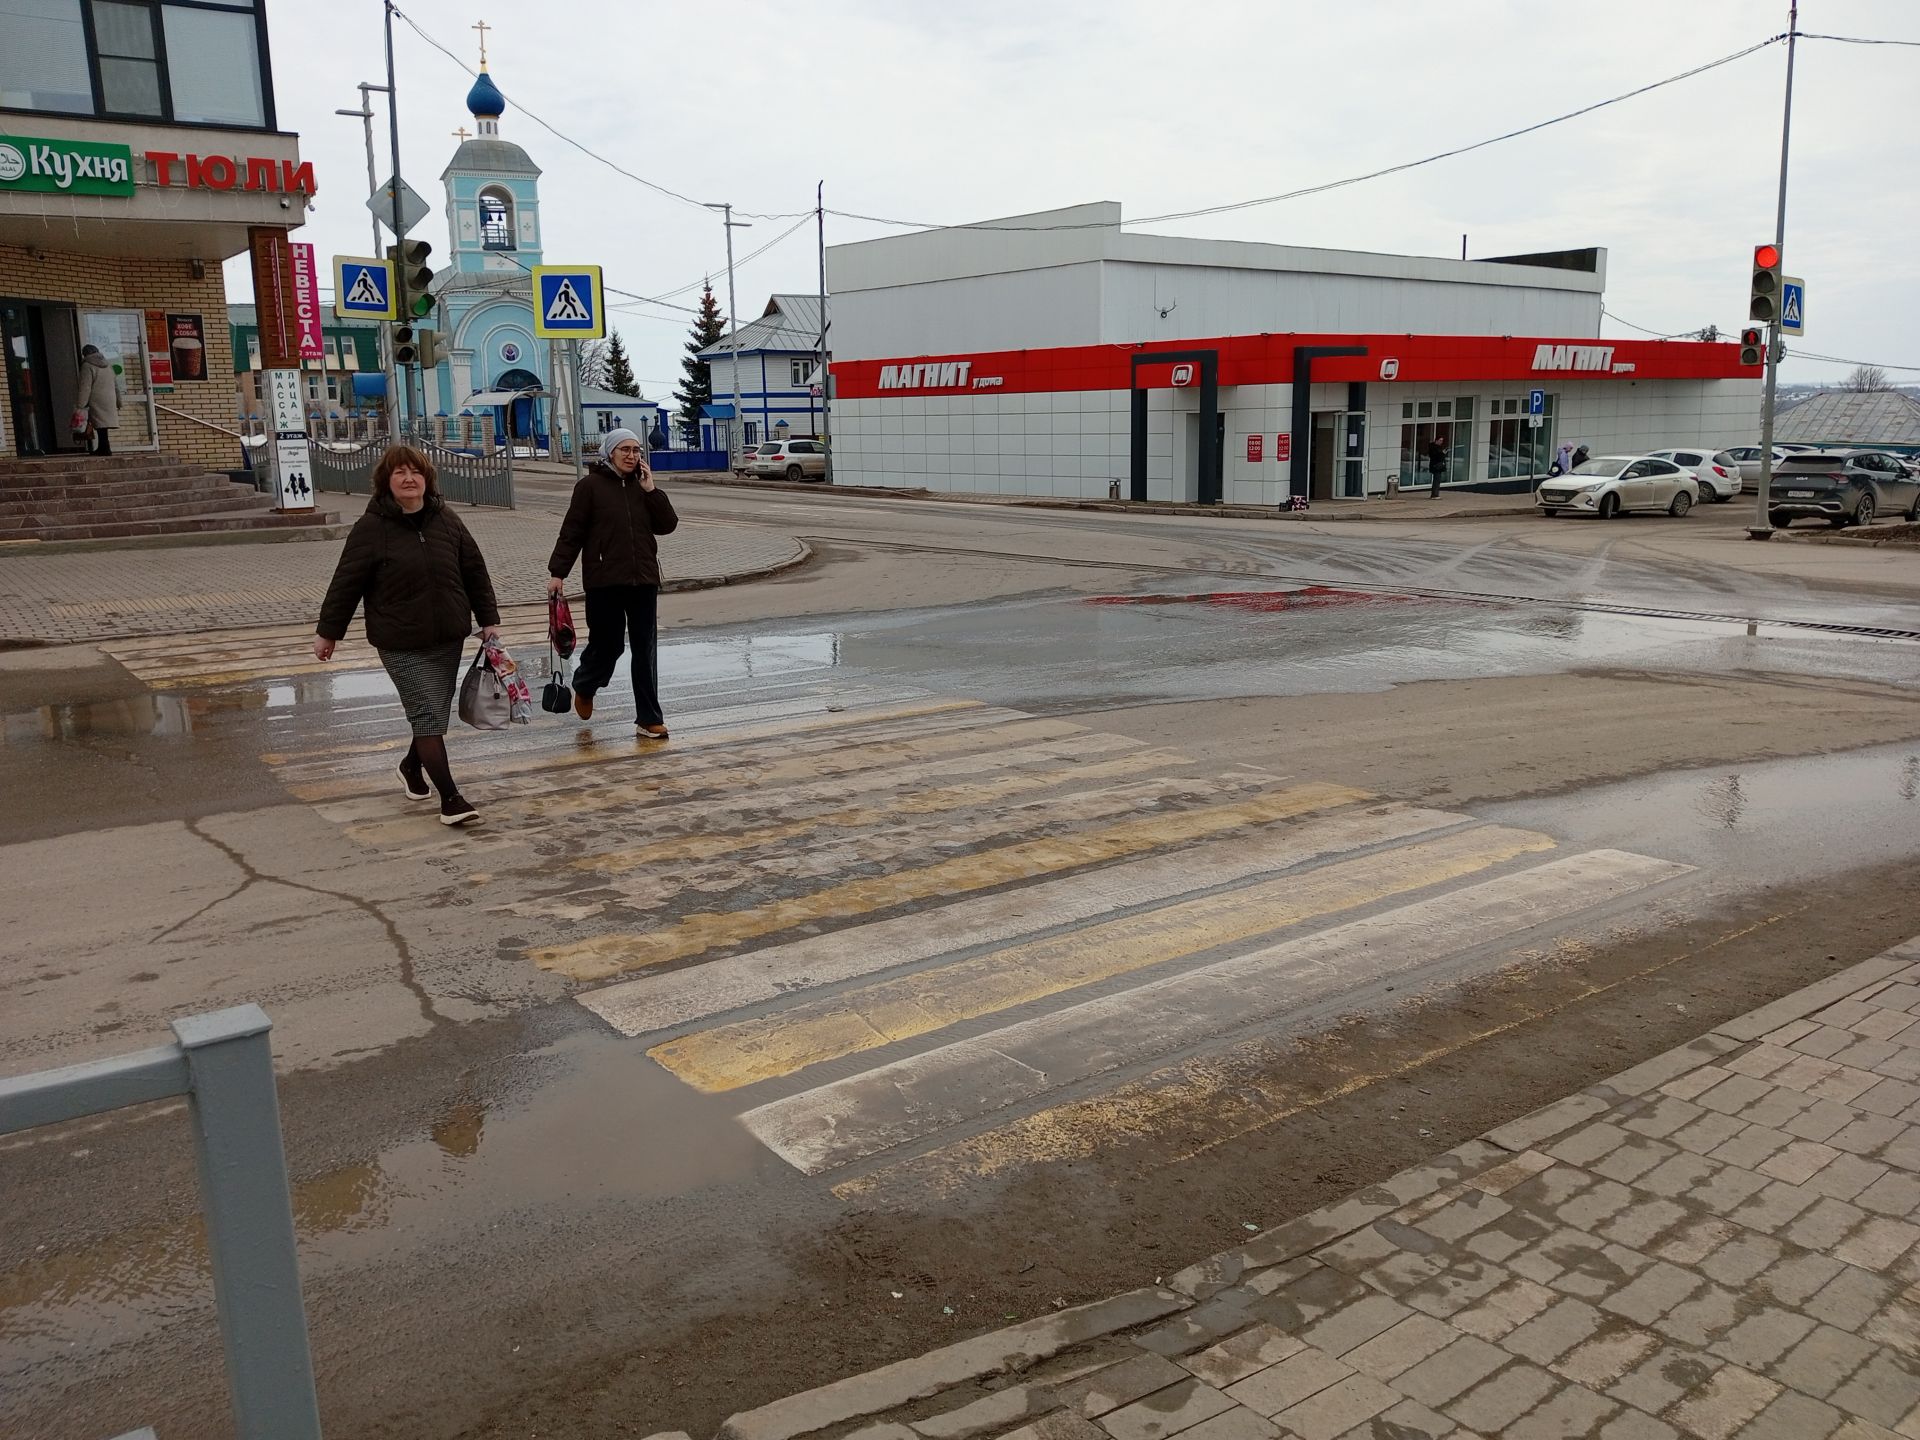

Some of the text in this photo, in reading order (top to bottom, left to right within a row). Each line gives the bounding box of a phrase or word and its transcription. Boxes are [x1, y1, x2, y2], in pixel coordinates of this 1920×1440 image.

[28, 144, 129, 188] Кухня
[145, 151, 316, 195] ТЮЛИ
[292, 244, 317, 348] НЕВЕСТА
[878, 362, 971, 389] МАГНИТ
[979, 377, 1003, 388] дома
[1532, 345, 1615, 371] МАГНИТ
[275, 372, 289, 429] МАССАЖ
[288, 372, 298, 409] ЛИЦА
[1532, 392, 1542, 412] P
